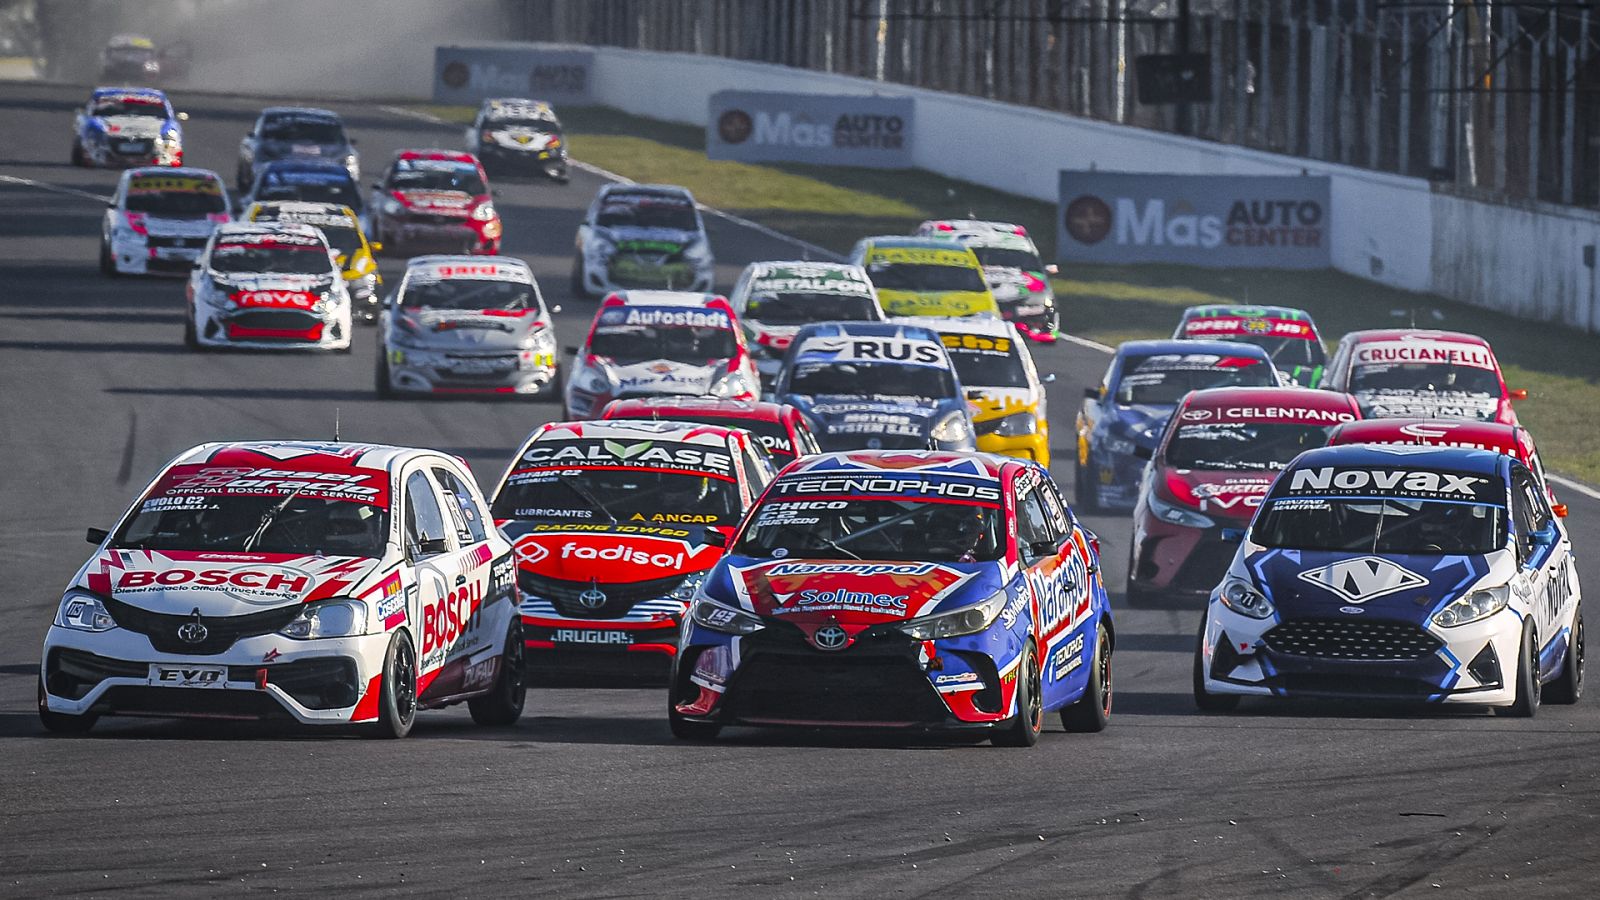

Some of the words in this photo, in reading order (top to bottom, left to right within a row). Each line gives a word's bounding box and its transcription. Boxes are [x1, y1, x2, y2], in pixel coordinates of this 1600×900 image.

[1226, 201, 1323, 226] AUTO
[1226, 226, 1321, 247] CENTER
[626, 309, 729, 329] Autostadt
[1186, 320, 1240, 332] OPEN
[853, 341, 940, 363] RUS
[1359, 348, 1489, 365] CRUCIANELLI
[1226, 407, 1356, 422] CELENTANO
[519, 460, 619, 469] EXCELENCIA
[165, 487, 223, 495] OFFICIAL
[227, 487, 273, 495] BOSCH
[277, 488, 320, 497] TRUCK
[322, 490, 376, 502] SERVICE
[776, 478, 1000, 500] TECNOPHOS
[185, 496, 205, 505] C2
[762, 501, 849, 512] CHICO
[515, 508, 593, 518] LUBRICANTES
[651, 513, 719, 523] ANCAP
[759, 510, 799, 520] C2
[532, 524, 612, 532] RACING
[615, 525, 690, 537] 10W60
[561, 542, 684, 570] fadisol
[768, 563, 936, 577] Naranpol
[117, 569, 311, 593] BOSCH
[114, 586, 146, 595] Diesel
[190, 584, 229, 592] Official
[230, 585, 258, 596] Truck
[259, 590, 299, 599] Service
[799, 588, 909, 608] Solmec
[422, 578, 482, 656] BOSCH
[708, 608, 737, 623] 193
[159, 669, 221, 682] EVO
